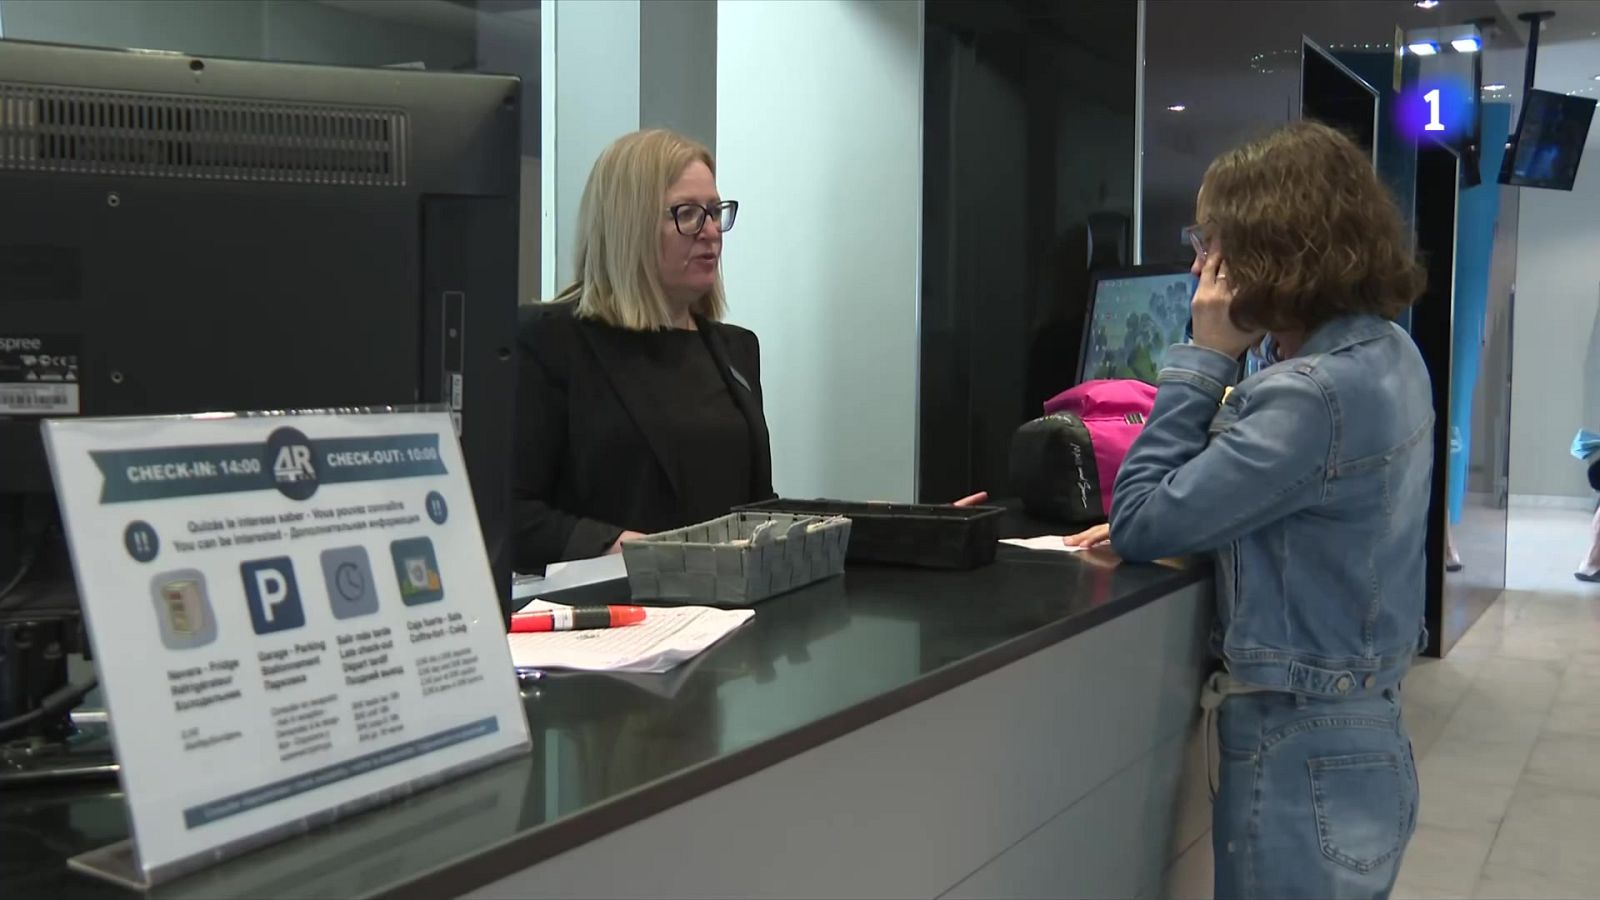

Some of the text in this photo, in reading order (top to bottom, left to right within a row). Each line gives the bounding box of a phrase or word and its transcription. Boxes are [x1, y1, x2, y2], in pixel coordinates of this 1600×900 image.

[327, 449, 405, 467] CHECK-OUT:
[126, 458, 261, 483] CHECK-IN: 14:00
[173, 541, 196, 552] You
[197, 538, 217, 549] can
[218, 536, 232, 546] be
[294, 640, 326, 653] Parking
